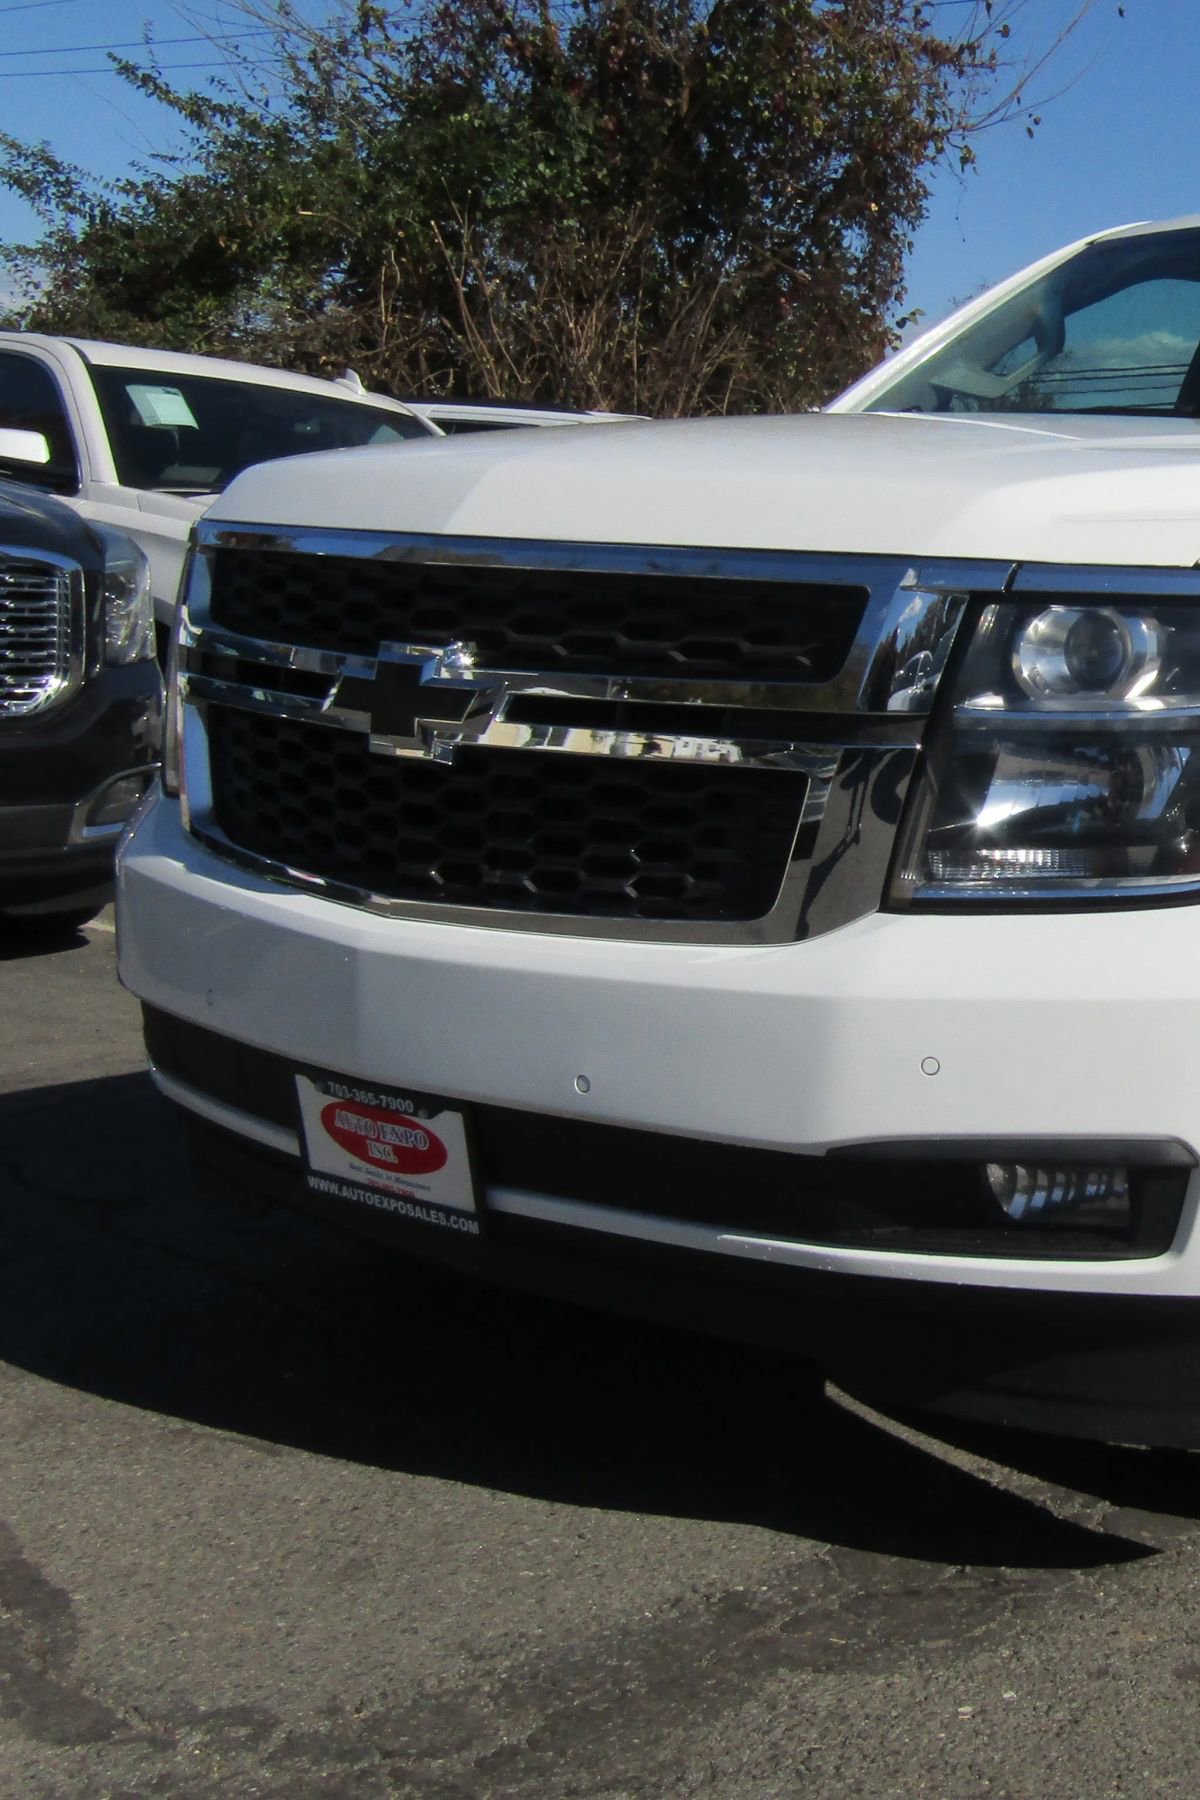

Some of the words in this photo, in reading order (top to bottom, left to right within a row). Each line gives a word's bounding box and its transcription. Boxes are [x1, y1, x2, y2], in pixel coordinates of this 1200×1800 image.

[327, 1081, 414, 1114] 703-365-7900
[335, 1109, 379, 1139] AUTO
[378, 1122, 429, 1150] EXPO
[307, 1175, 480, 1235] WWW.AUTOEXPOSALES.COM
